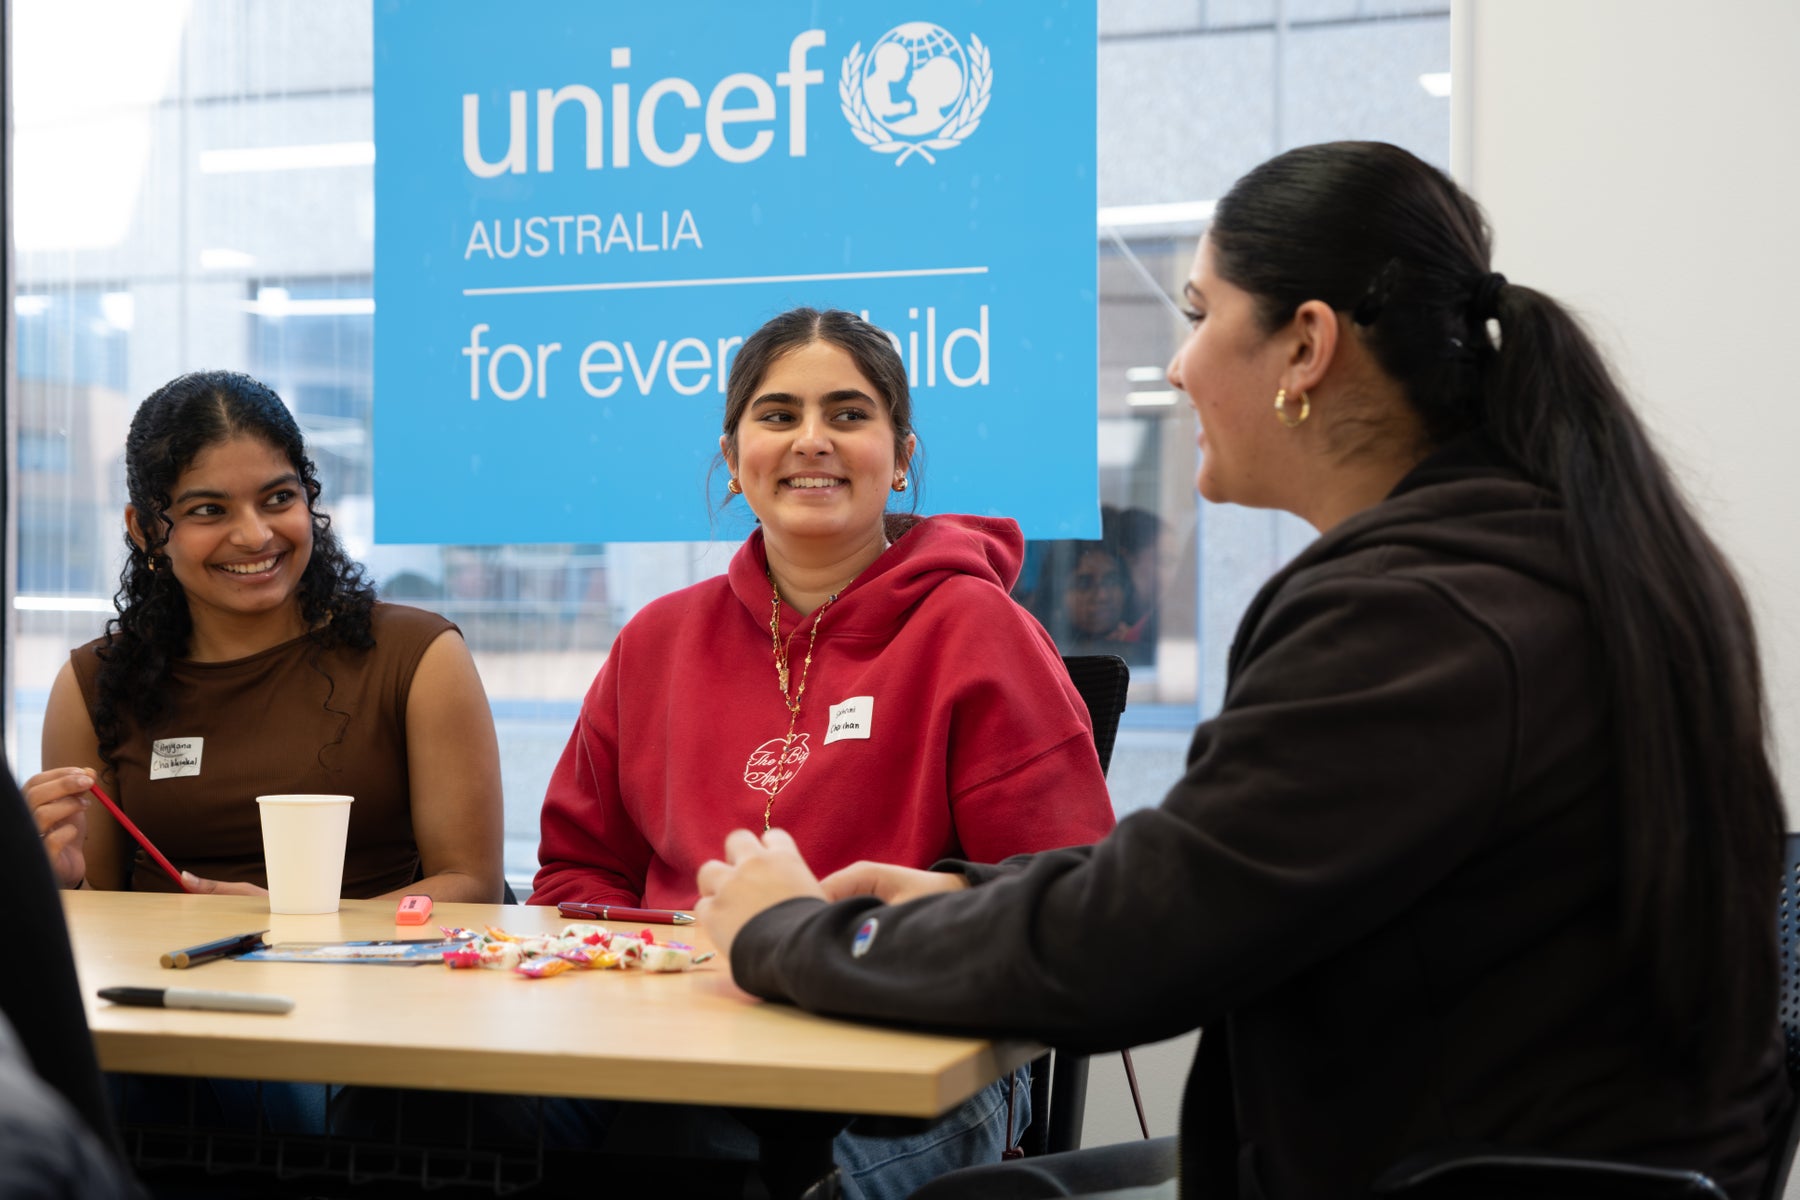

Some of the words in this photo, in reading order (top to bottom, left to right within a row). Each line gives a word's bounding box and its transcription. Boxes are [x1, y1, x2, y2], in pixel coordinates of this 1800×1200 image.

[462, 29, 826, 178] unicef
[465, 210, 703, 260] AUSTRALIA
[462, 324, 561, 400] for
[579, 336, 743, 398] ever
[861, 304, 990, 388] ild
[747, 751, 777, 767] The
[783, 746, 810, 764] Big
